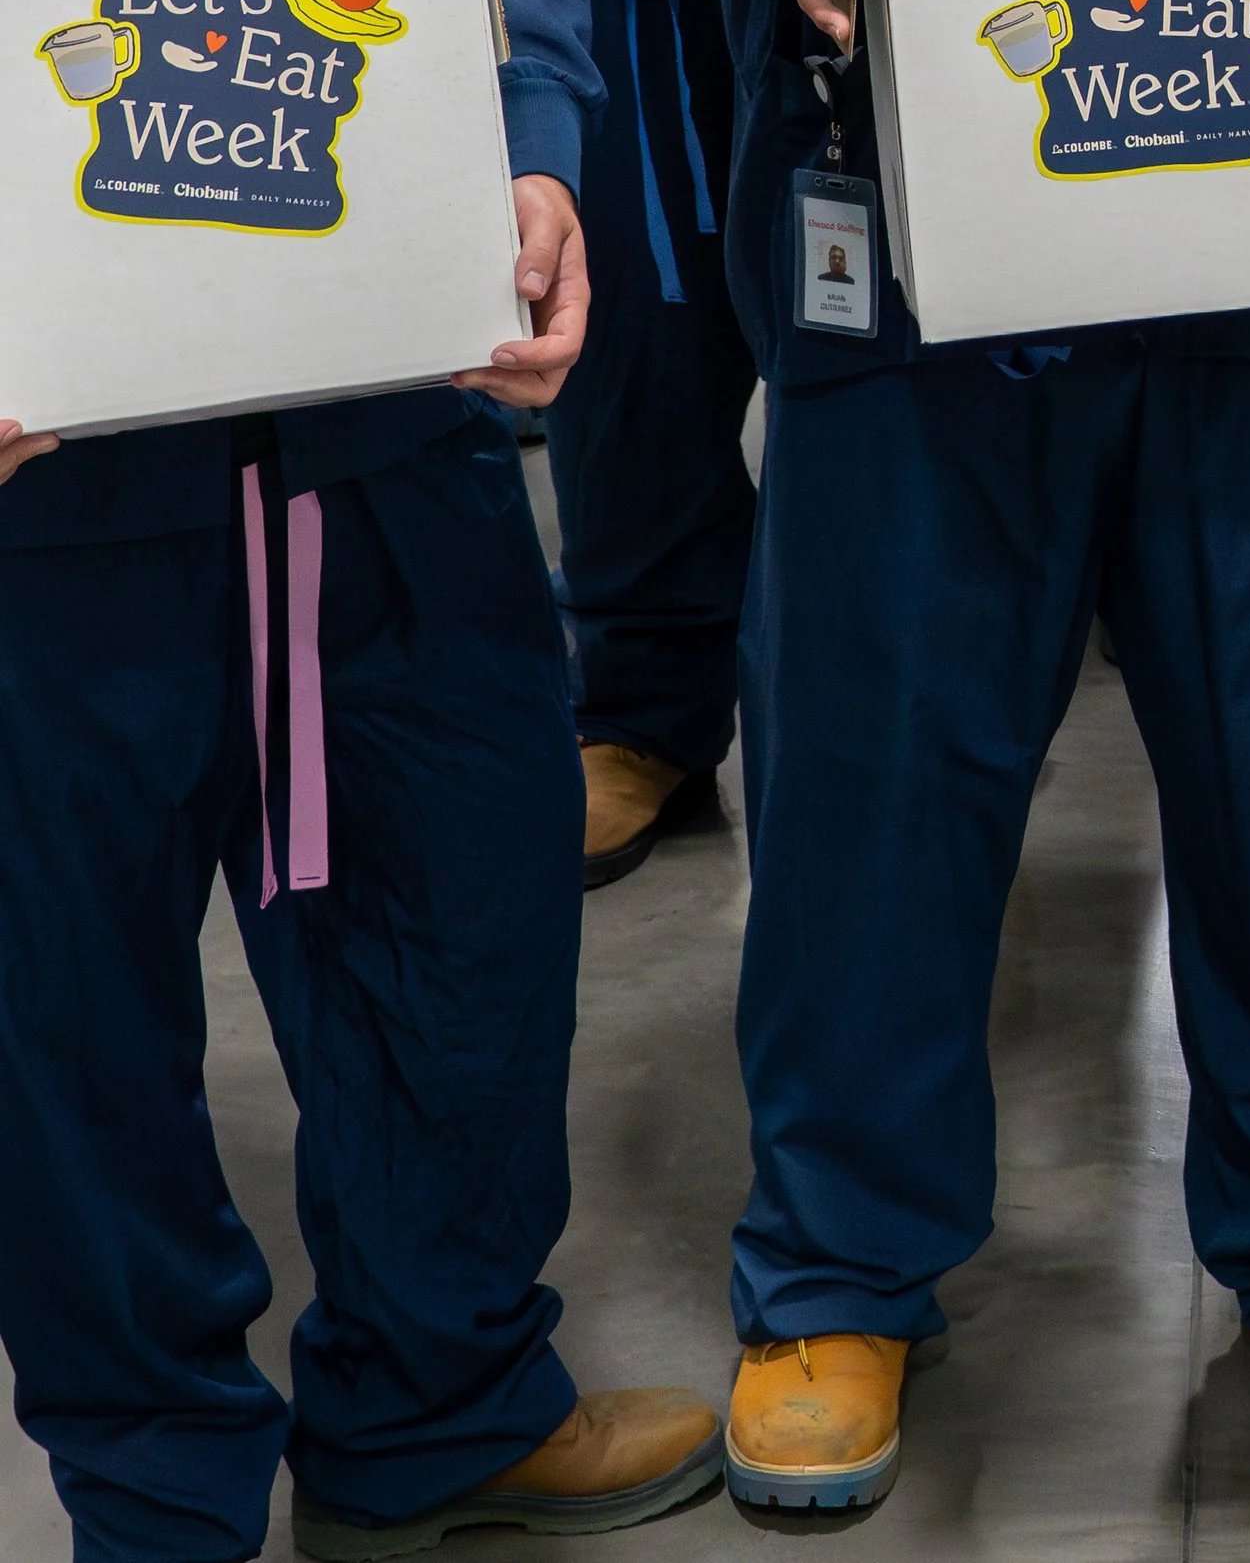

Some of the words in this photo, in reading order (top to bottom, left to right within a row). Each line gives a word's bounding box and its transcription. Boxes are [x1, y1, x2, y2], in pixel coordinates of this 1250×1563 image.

[230, 25, 346, 105] Eat
[1061, 50, 1246, 122] Week
[119, 99, 312, 173] Week
[1064, 140, 1113, 154] COLOMBE
[1125, 130, 1185, 149] Chobani
[1197, 132, 1223, 140] DAILY
[107, 180, 161, 195] COLOMBE
[174, 182, 239, 202] Chobani
[251, 194, 280, 203] DAILY
[285, 197, 331, 207] HARVEST
